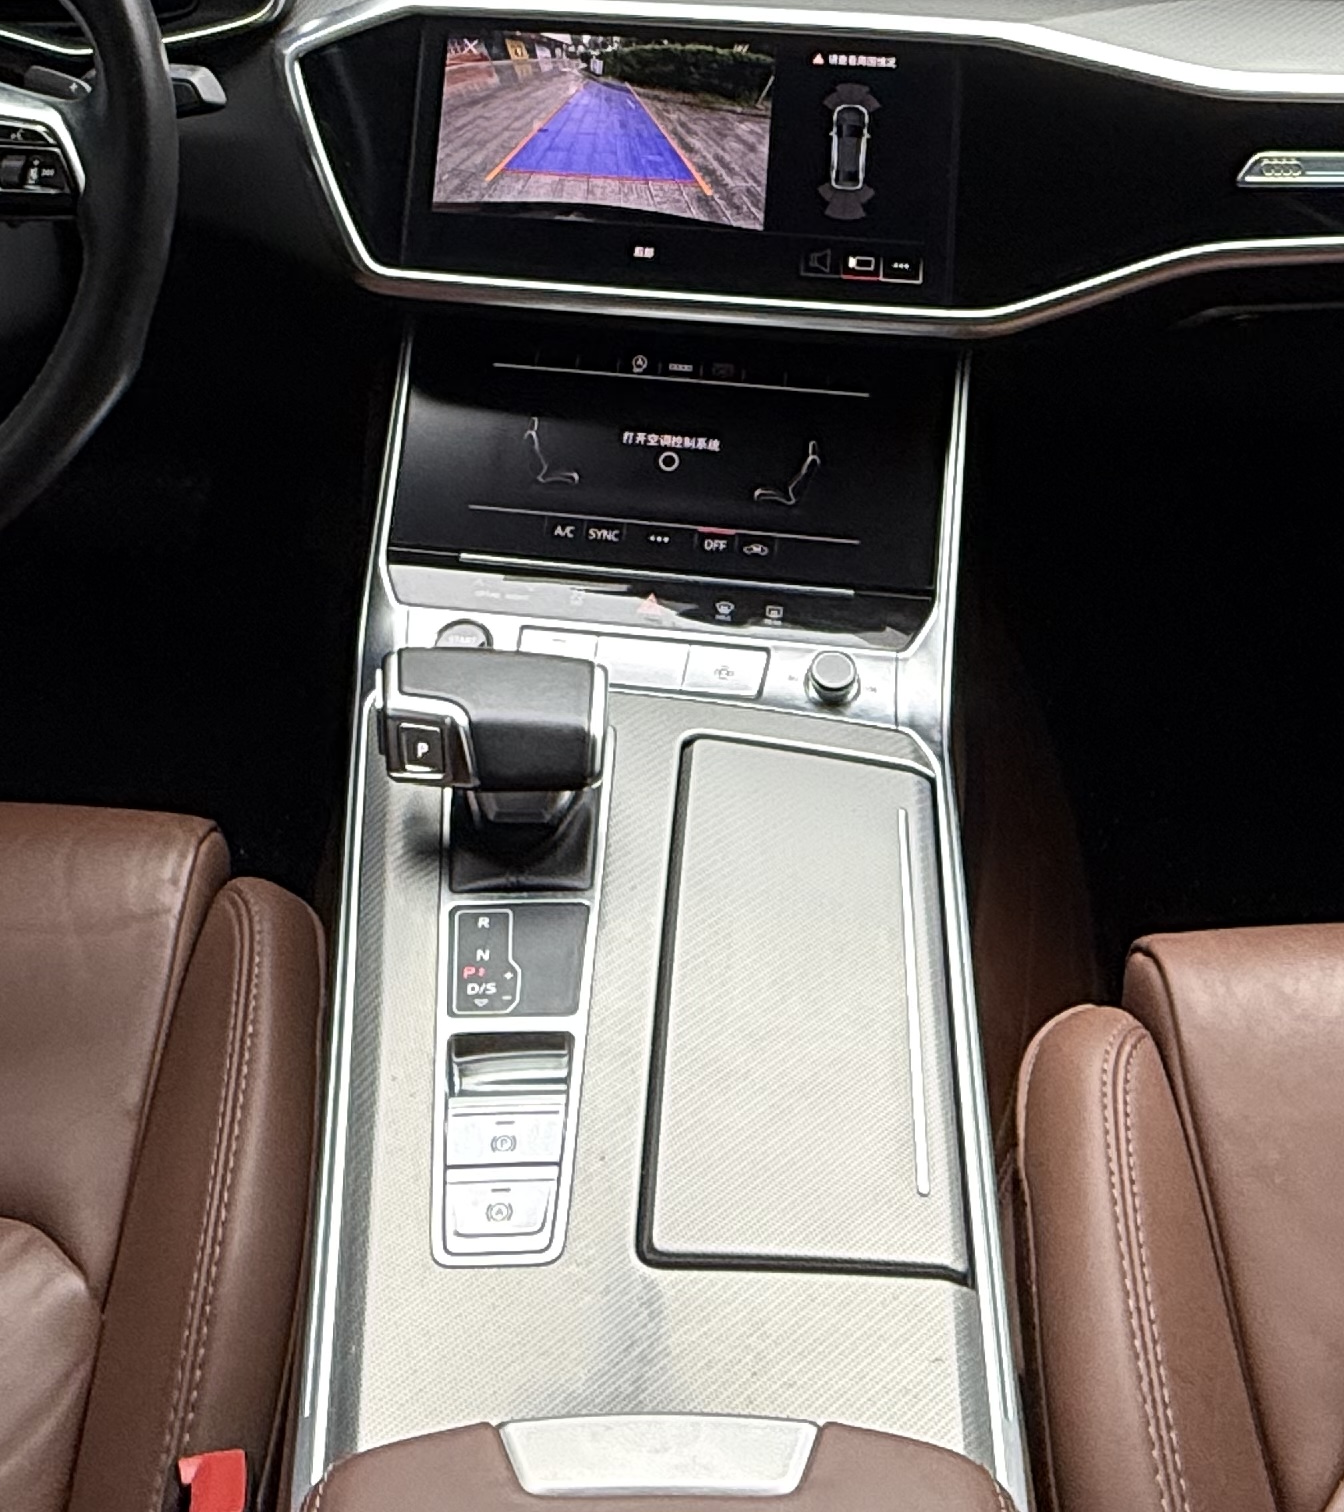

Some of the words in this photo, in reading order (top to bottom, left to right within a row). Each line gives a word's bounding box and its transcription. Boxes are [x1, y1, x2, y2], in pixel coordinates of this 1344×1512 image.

[622, 431, 721, 452] 打开空调控制系统
[554, 524, 575, 539] A/C
[588, 528, 620, 542] SYNC
[704, 538, 728, 552] OFF
[416, 743, 429, 758] P
[478, 917, 489, 928] R
[476, 949, 489, 961] N
[467, 982, 497, 995] D/S
